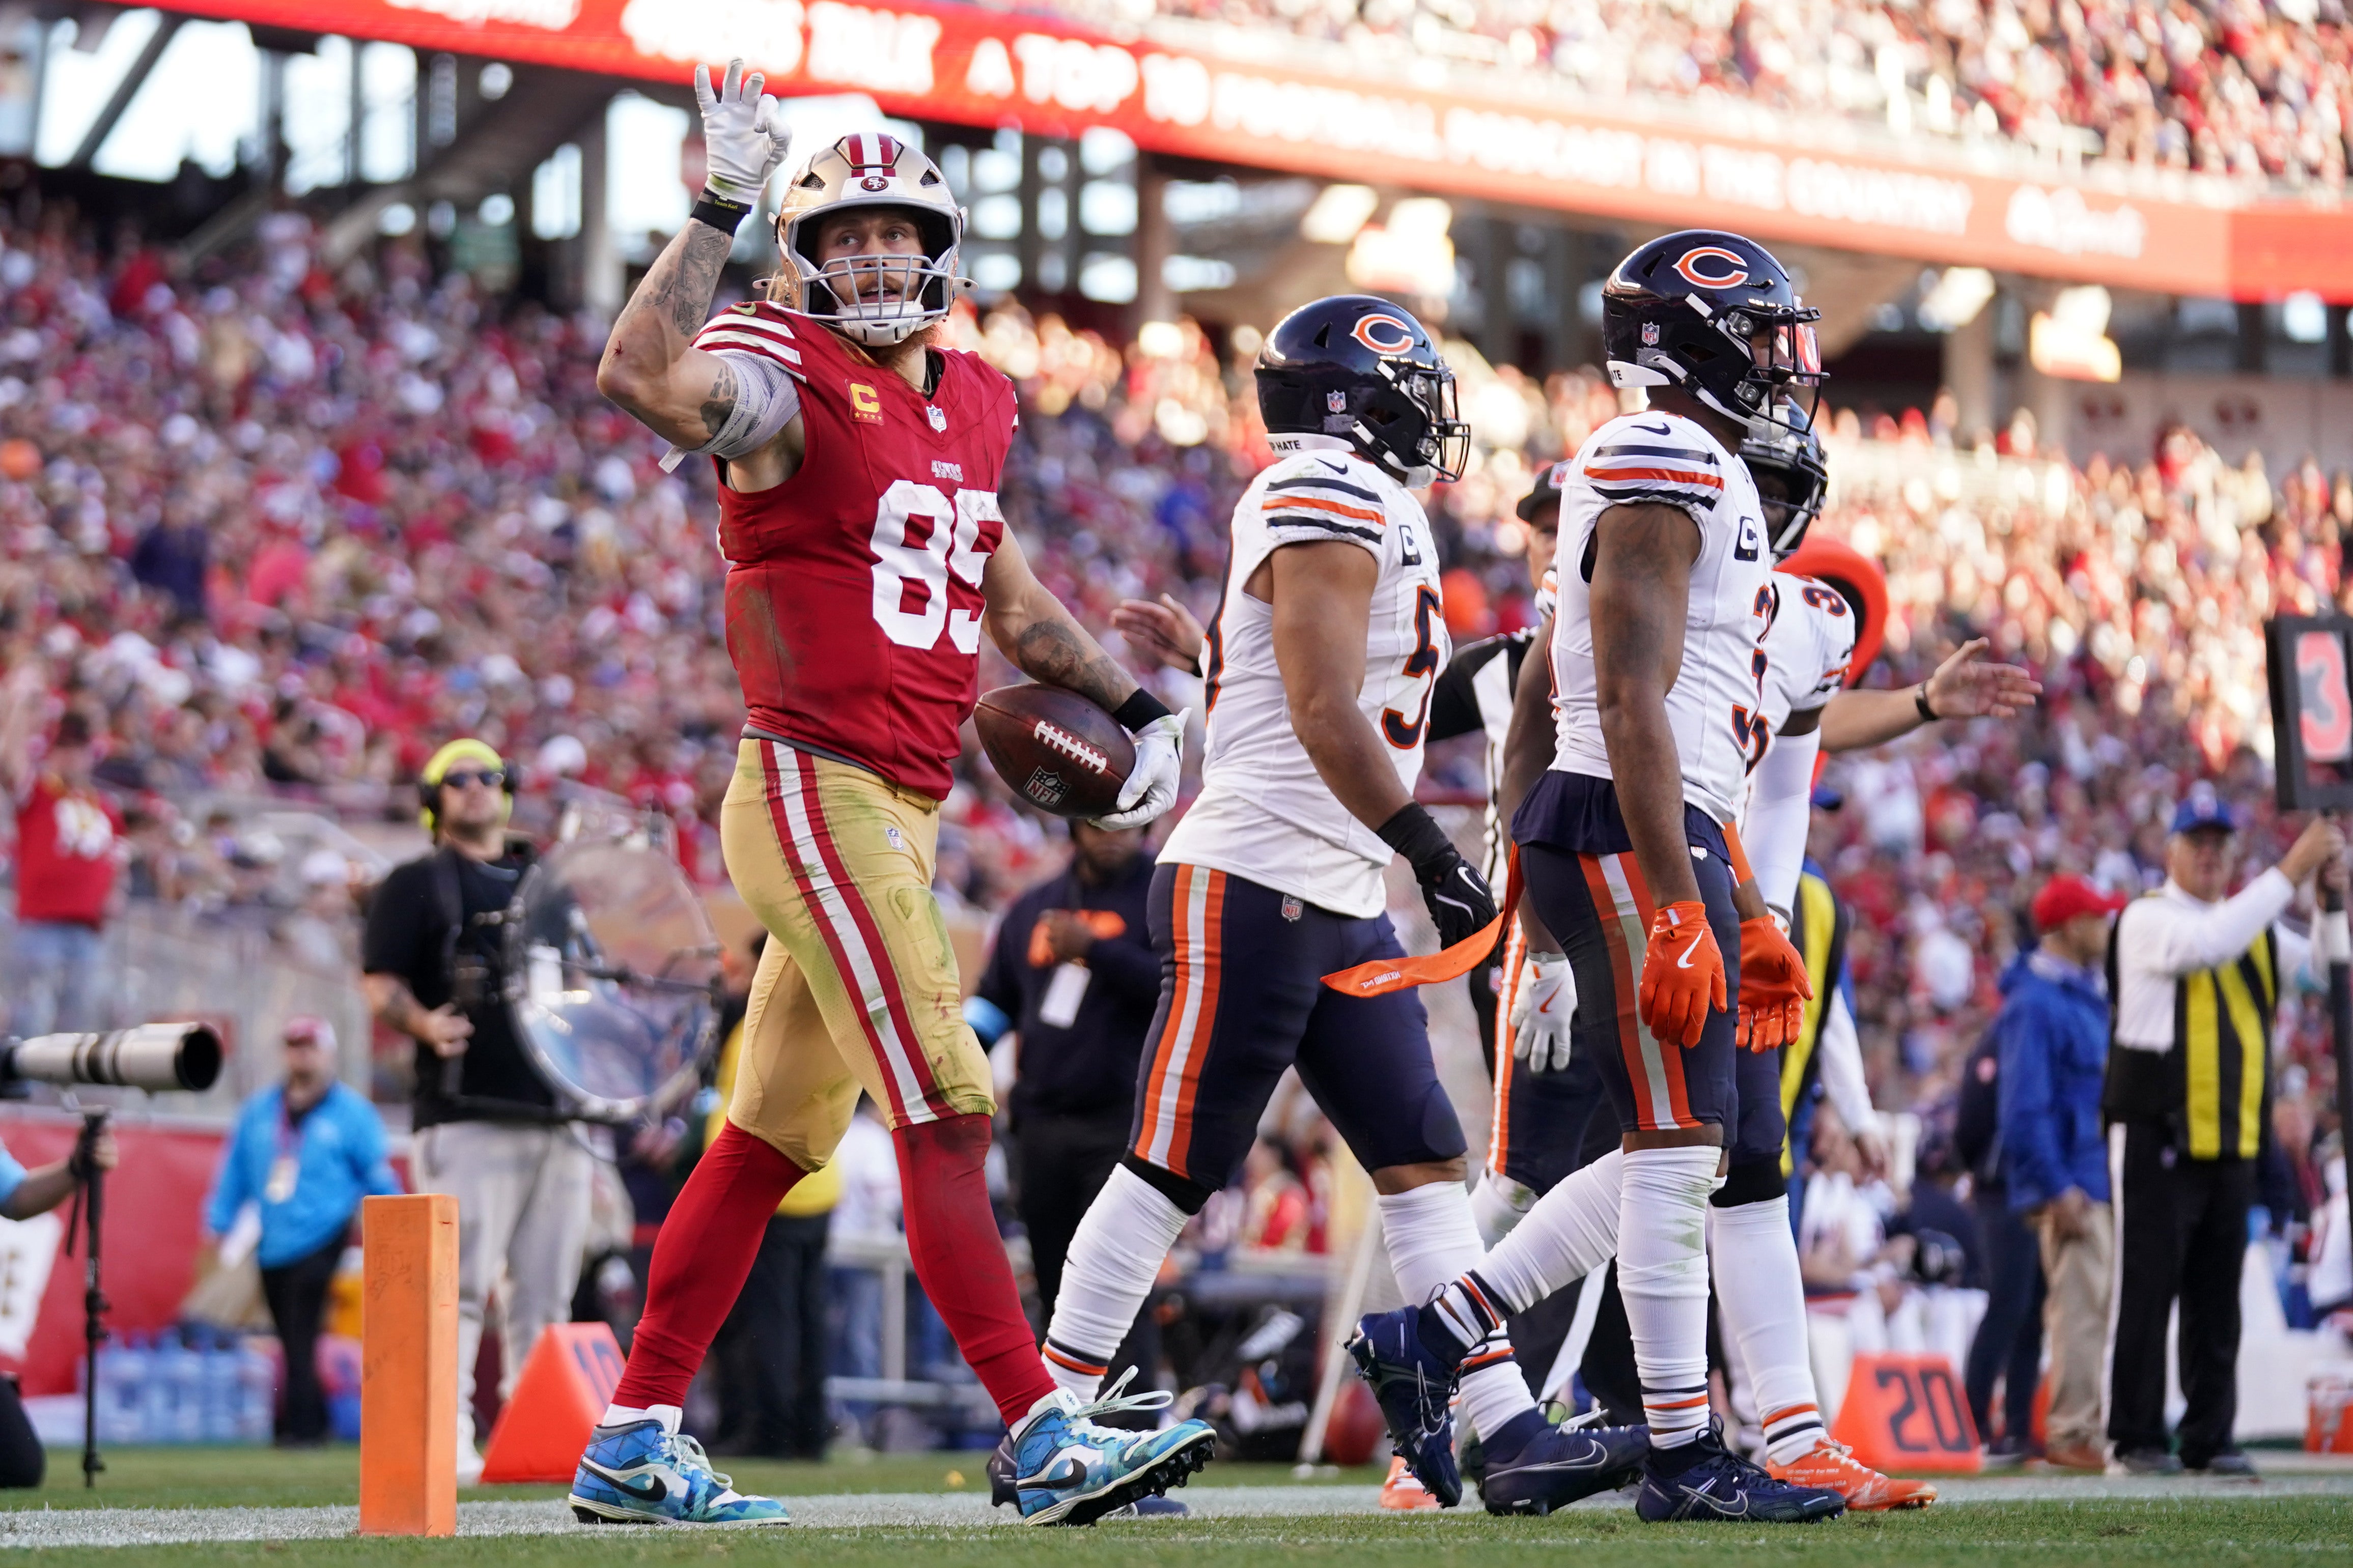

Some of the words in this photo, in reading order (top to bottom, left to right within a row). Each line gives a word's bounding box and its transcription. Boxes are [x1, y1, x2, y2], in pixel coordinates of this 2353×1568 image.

[965, 37, 1015, 98] A
[1013, 32, 1139, 115] TOP
[1211, 72, 1445, 162] FOOTBALL
[1445, 106, 1643, 188] PODCAST
[1644, 136, 1700, 196] IN
[1701, 142, 1786, 210] THE
[1786, 156, 1973, 236] COUNTRY
[714, 199, 727, 207] Team
[1672, 246, 1748, 289] C
[1350, 313, 1414, 355] C
[1644, 331, 1657, 343] NFL
[850, 382, 880, 413] C
[1275, 440, 1302, 451] HATE
[1401, 526, 1418, 556] C
[1741, 518, 1758, 550] C
[870, 479, 1003, 654] 85
[2295, 632, 2352, 762] 3
[1026, 782, 1056, 806] NFL
[1285, 904, 1300, 916] NFL
[1875, 1369, 1971, 1452] 20
